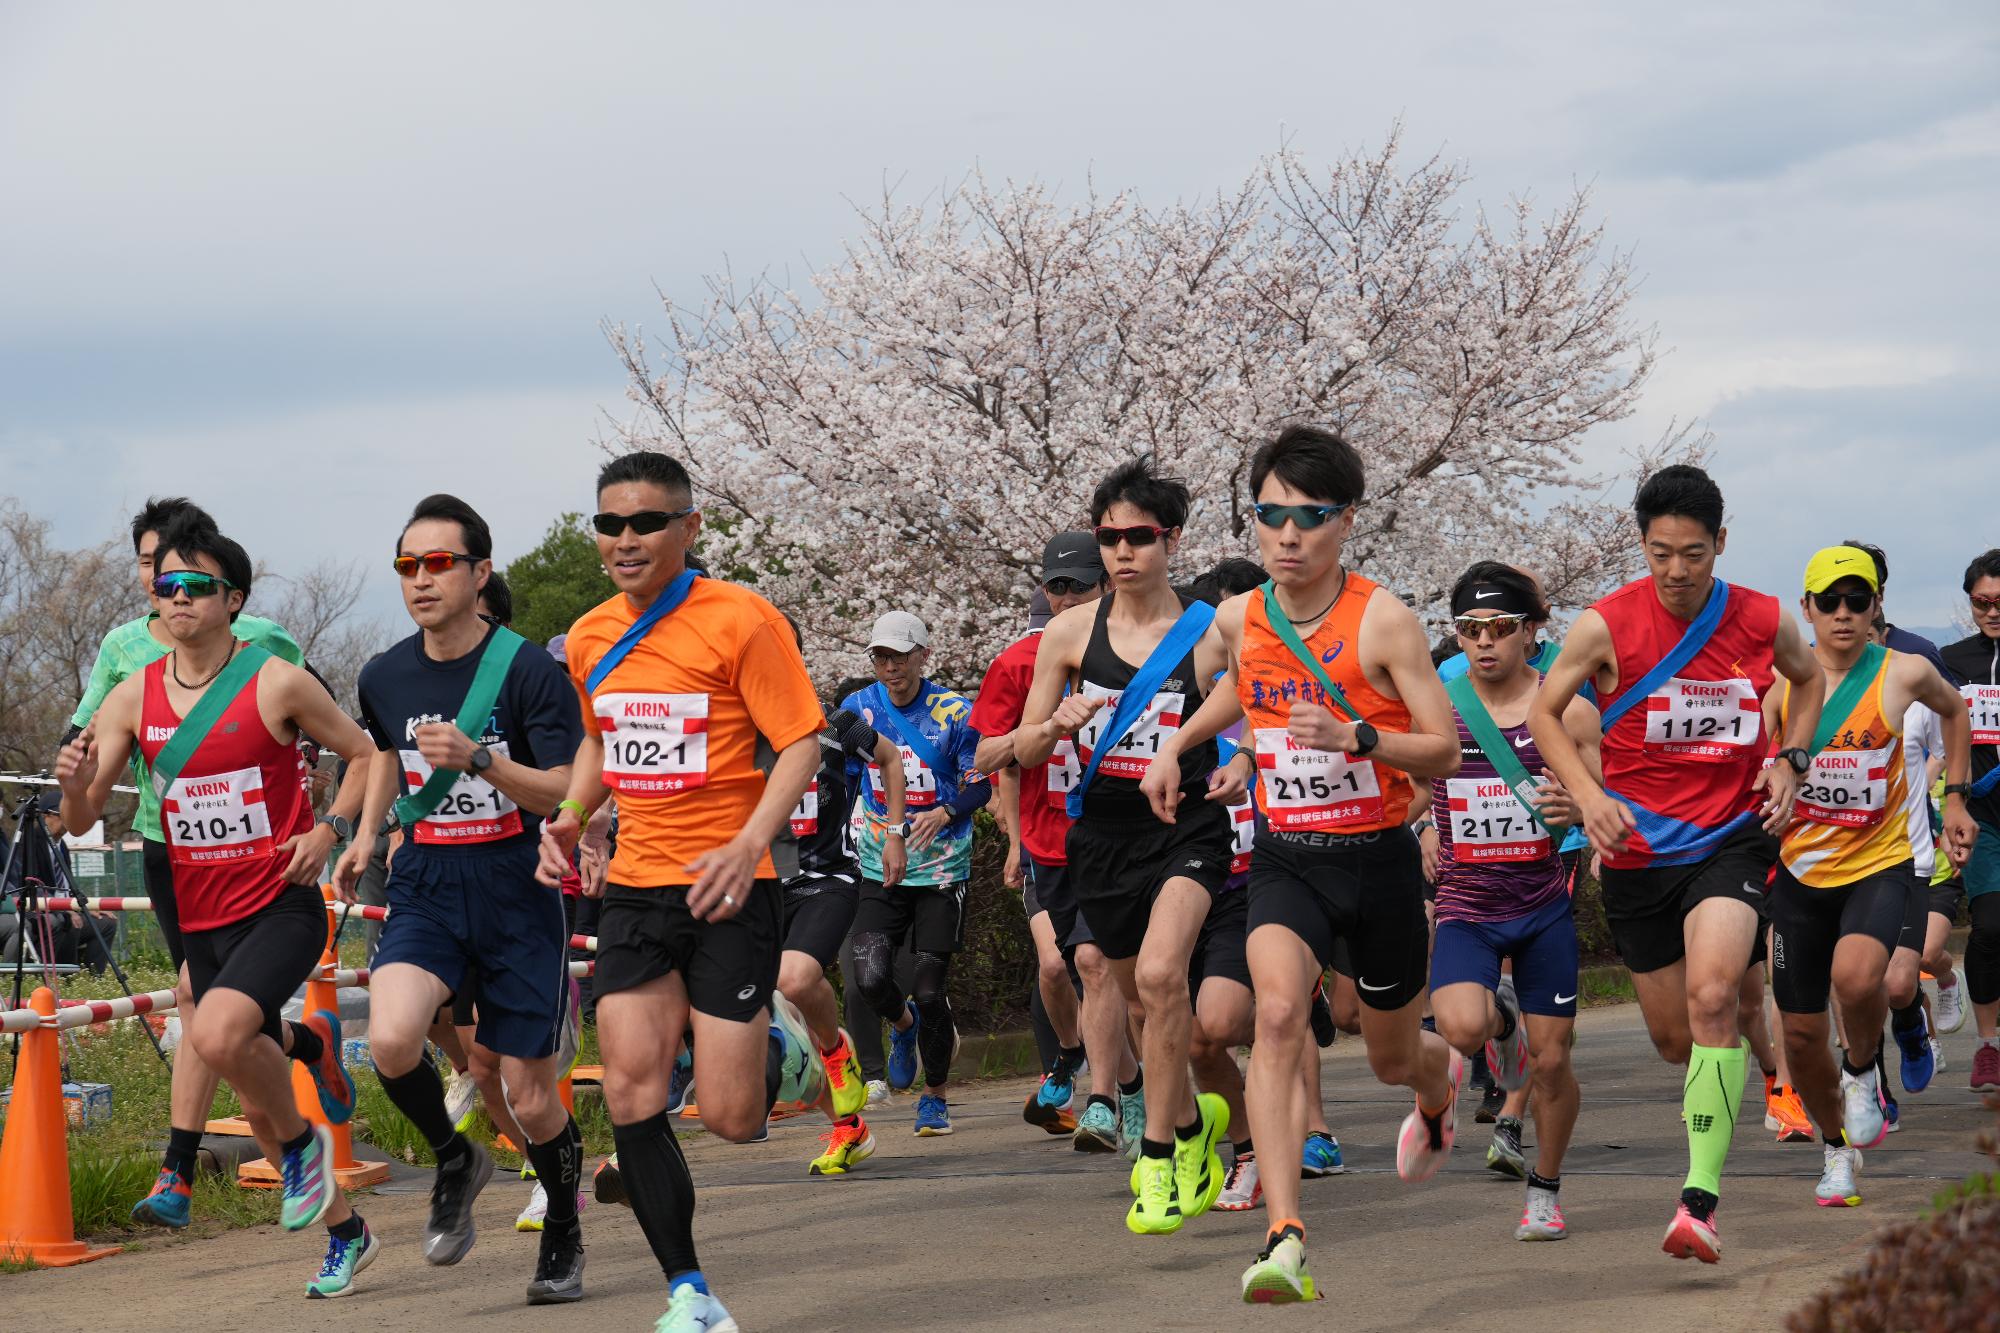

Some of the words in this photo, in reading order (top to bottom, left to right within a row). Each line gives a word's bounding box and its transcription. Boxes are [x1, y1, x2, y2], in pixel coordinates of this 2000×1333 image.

[1681, 684, 1729, 697] KIRIN
[624, 702, 670, 717] KIRIN
[146, 725, 178, 742] Atsu
[1088, 725, 1160, 753] 14-1
[1662, 716, 1742, 739] 112-1
[613, 740, 686, 766] 102-1
[1815, 757, 1858, 769] KIRIN
[185, 780, 230, 798] KIRIN
[1274, 770, 1359, 800] 215-1
[1801, 782, 1872, 805] 230-1
[431, 788, 502, 816] 26-1
[177, 813, 254, 841] 210-1
[1461, 815, 1538, 838] 217-1
[1272, 831, 1325, 847] NIKE
[1326, 832, 1383, 848] PRO
